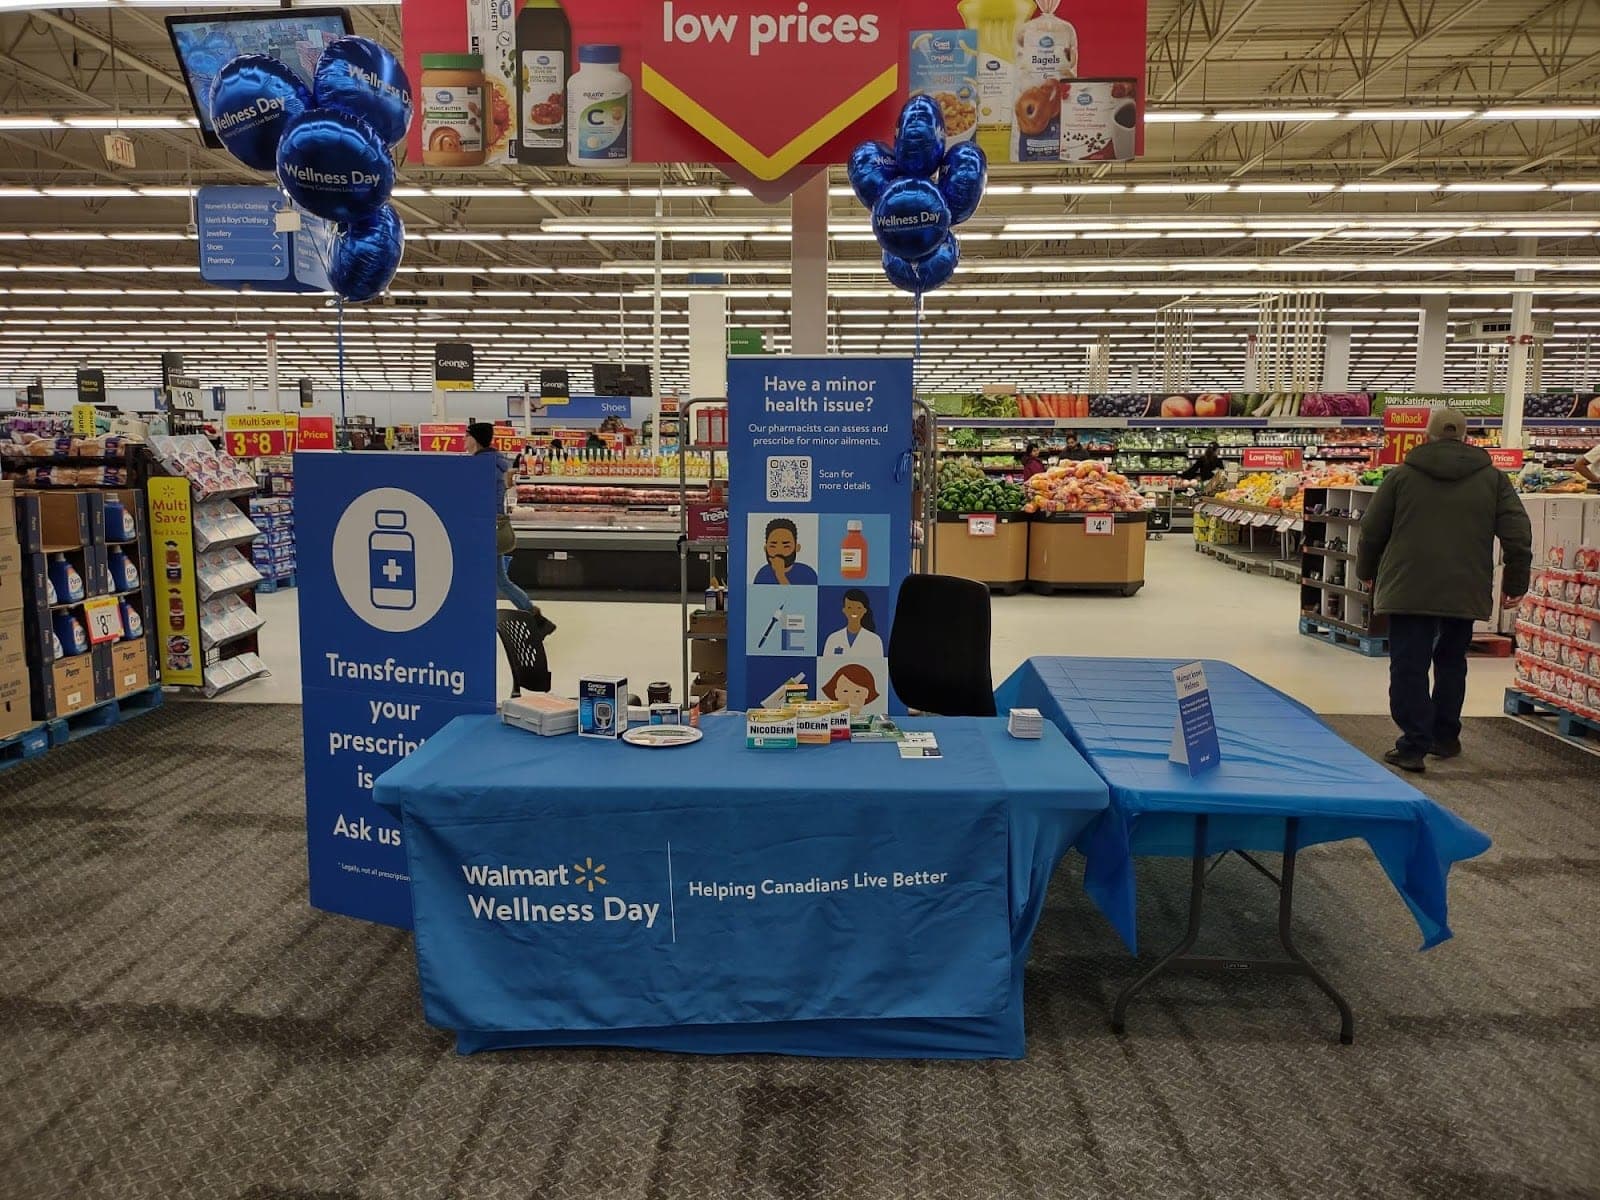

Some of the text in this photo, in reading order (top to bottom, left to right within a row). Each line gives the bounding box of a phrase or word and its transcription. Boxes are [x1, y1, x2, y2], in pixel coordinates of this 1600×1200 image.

[663, 1, 879, 55] low prices
[1031, 55, 1060, 65] Bagels
[348, 64, 401, 99] Wellness
[214, 96, 285, 132] Wellness Day
[587, 109, 604, 125] C
[284, 162, 380, 187] Wellness Day
[241, 217, 269, 225] Clothing
[876, 211, 940, 226] Wellness Day
[207, 257, 235, 265] Pharmacy
[764, 376, 876, 391] Have a minor
[601, 403, 626, 411] Shoes
[765, 397, 874, 412] health issue?
[1384, 396, 1491, 406] 100% Satisfaction Guaranteed
[239, 418, 260, 426] Multi
[262, 418, 281, 426] Save
[1390, 412, 1423, 425] Rollback
[303, 430, 329, 439] Prices
[749, 424, 888, 434] Our pharmacists can assess and
[234, 432, 246, 455] 3
[753, 437, 881, 447] prescribe for minor ailments.
[1249, 453, 1264, 461] Low
[1494, 454, 1515, 462] Prices
[819, 469, 854, 478] Scan for
[818, 482, 871, 490] more details
[153, 499, 187, 511] Multi
[155, 511, 186, 523] Save
[326, 653, 465, 694] Transferring
[369, 700, 420, 724] your
[329, 732, 426, 757] prescrip
[357, 765, 373, 789] is
[333, 814, 401, 846] Ask us
[341, 862, 360, 874] Legally,
[463, 864, 569, 887] Walmart
[689, 869, 948, 901] Helping Canadians Live Better
[468, 895, 660, 928] Wellness Day
